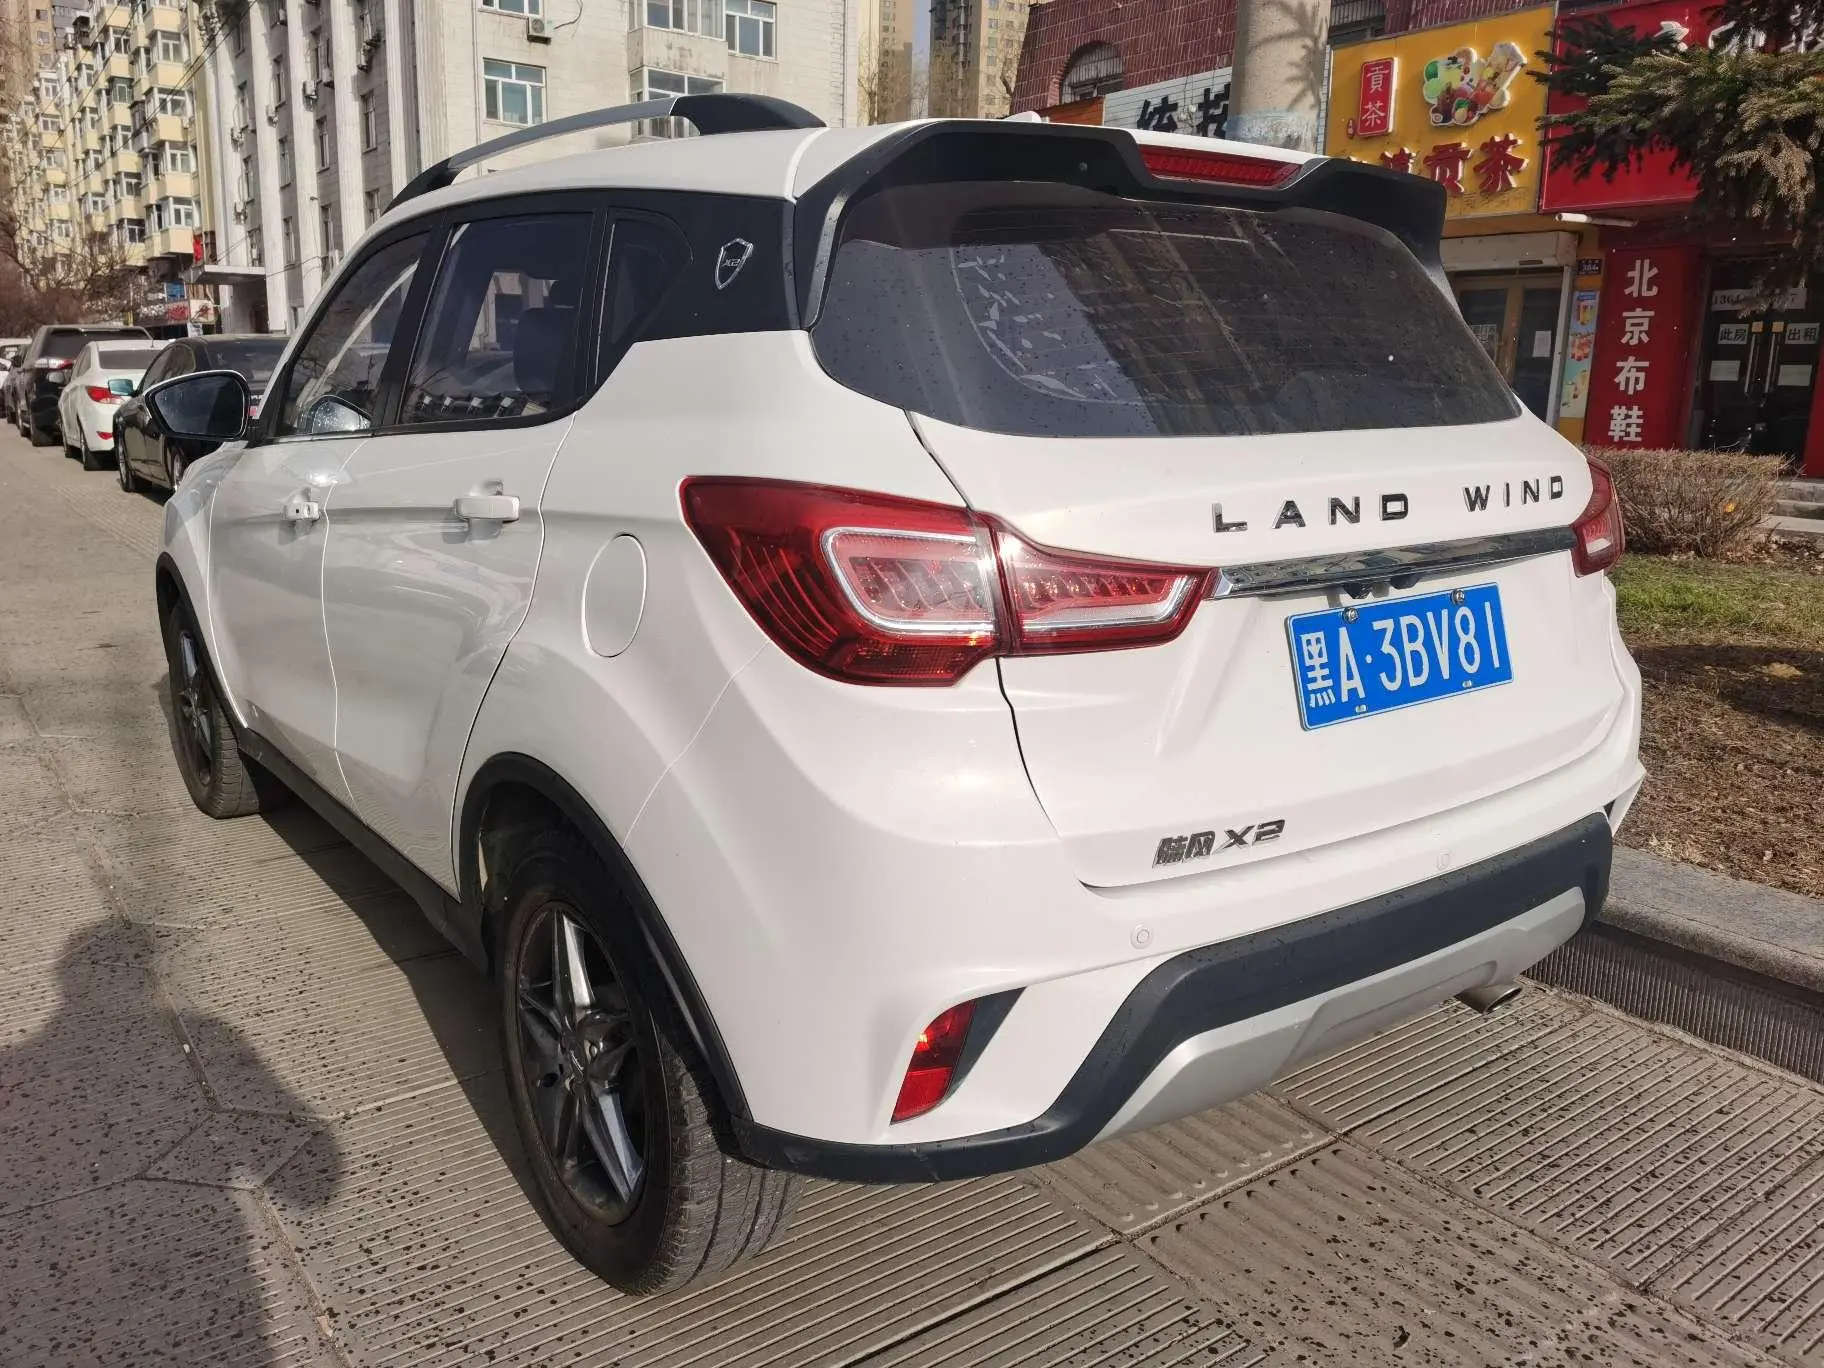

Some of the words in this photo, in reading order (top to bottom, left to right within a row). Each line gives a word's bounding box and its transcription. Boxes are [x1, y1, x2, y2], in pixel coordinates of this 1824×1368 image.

[1607, 258, 1660, 442] 北京布鞋
[1211, 493, 1409, 533] LAND
[1463, 475, 1564, 512] WIND
[1300, 601, 1500, 708] 黑A·3BV81
[1217, 819, 1286, 850] X2
